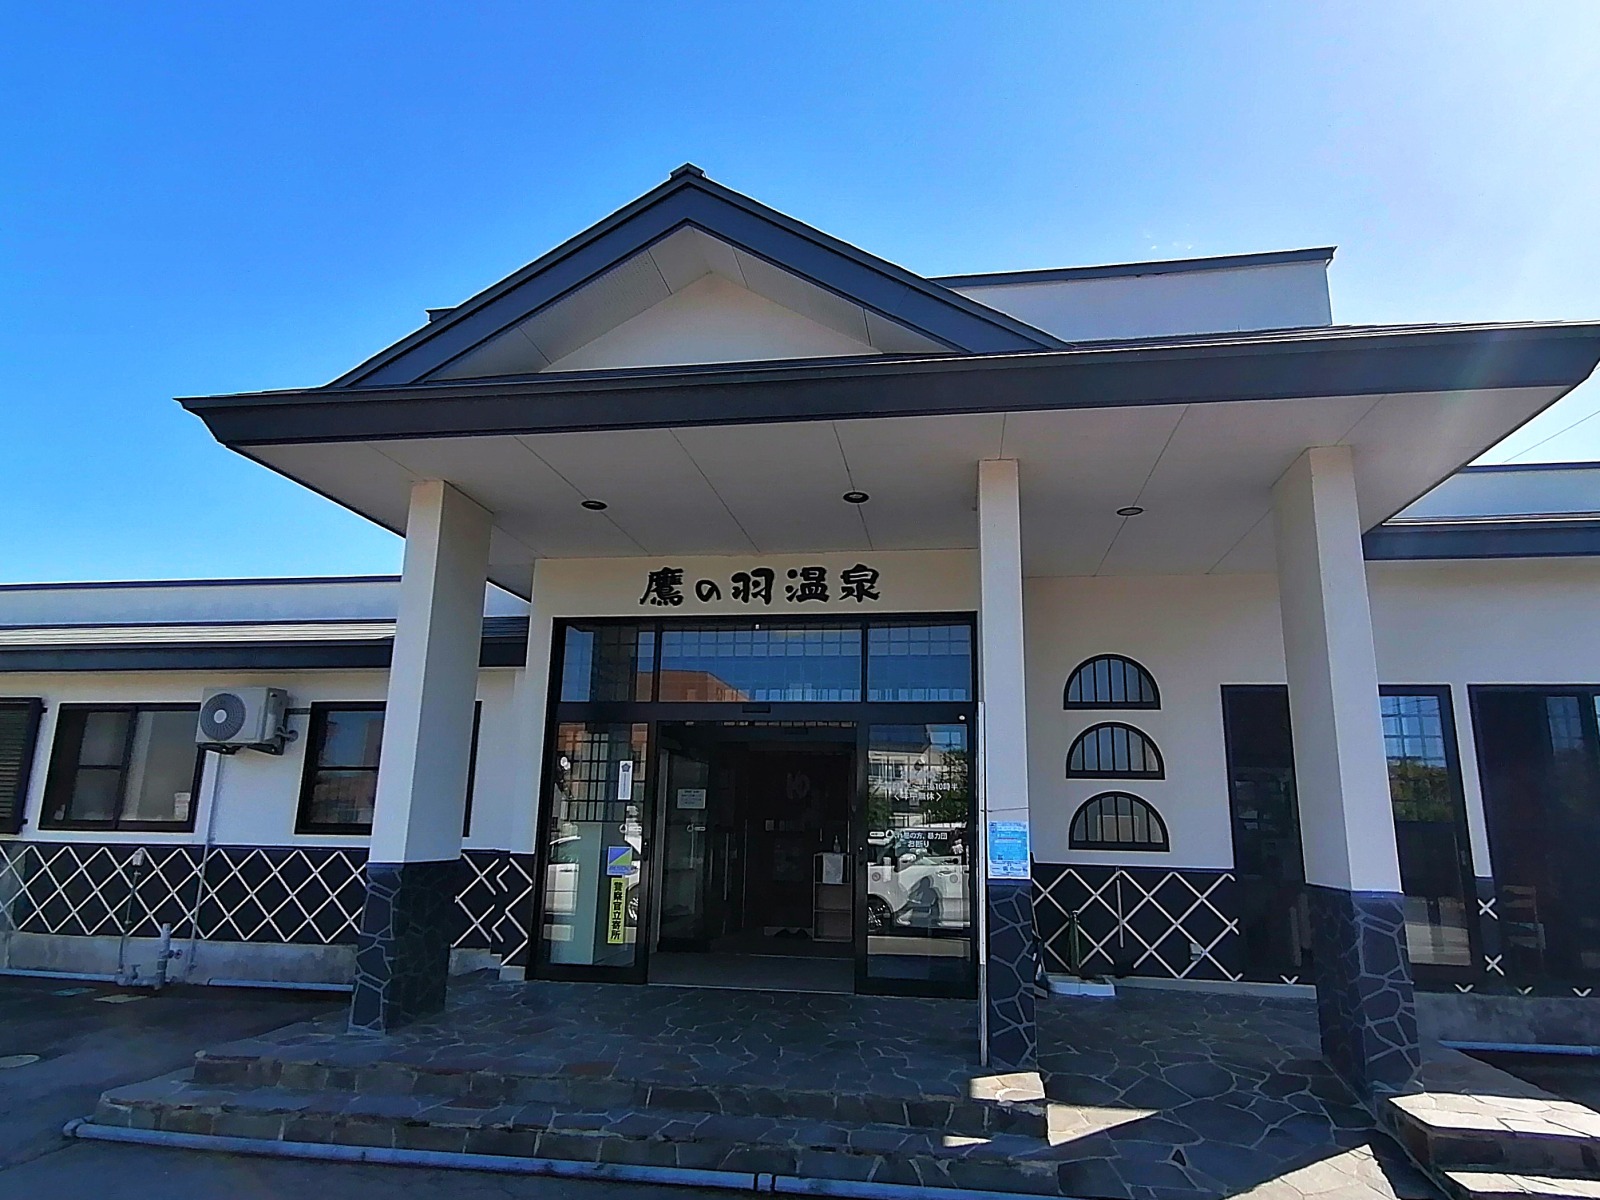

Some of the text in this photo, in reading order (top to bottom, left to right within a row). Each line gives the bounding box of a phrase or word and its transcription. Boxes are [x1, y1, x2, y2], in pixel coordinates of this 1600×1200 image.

[639, 564, 880, 606] 鷹の羽温泉
[610, 882, 623, 940] 警察官立寄所
